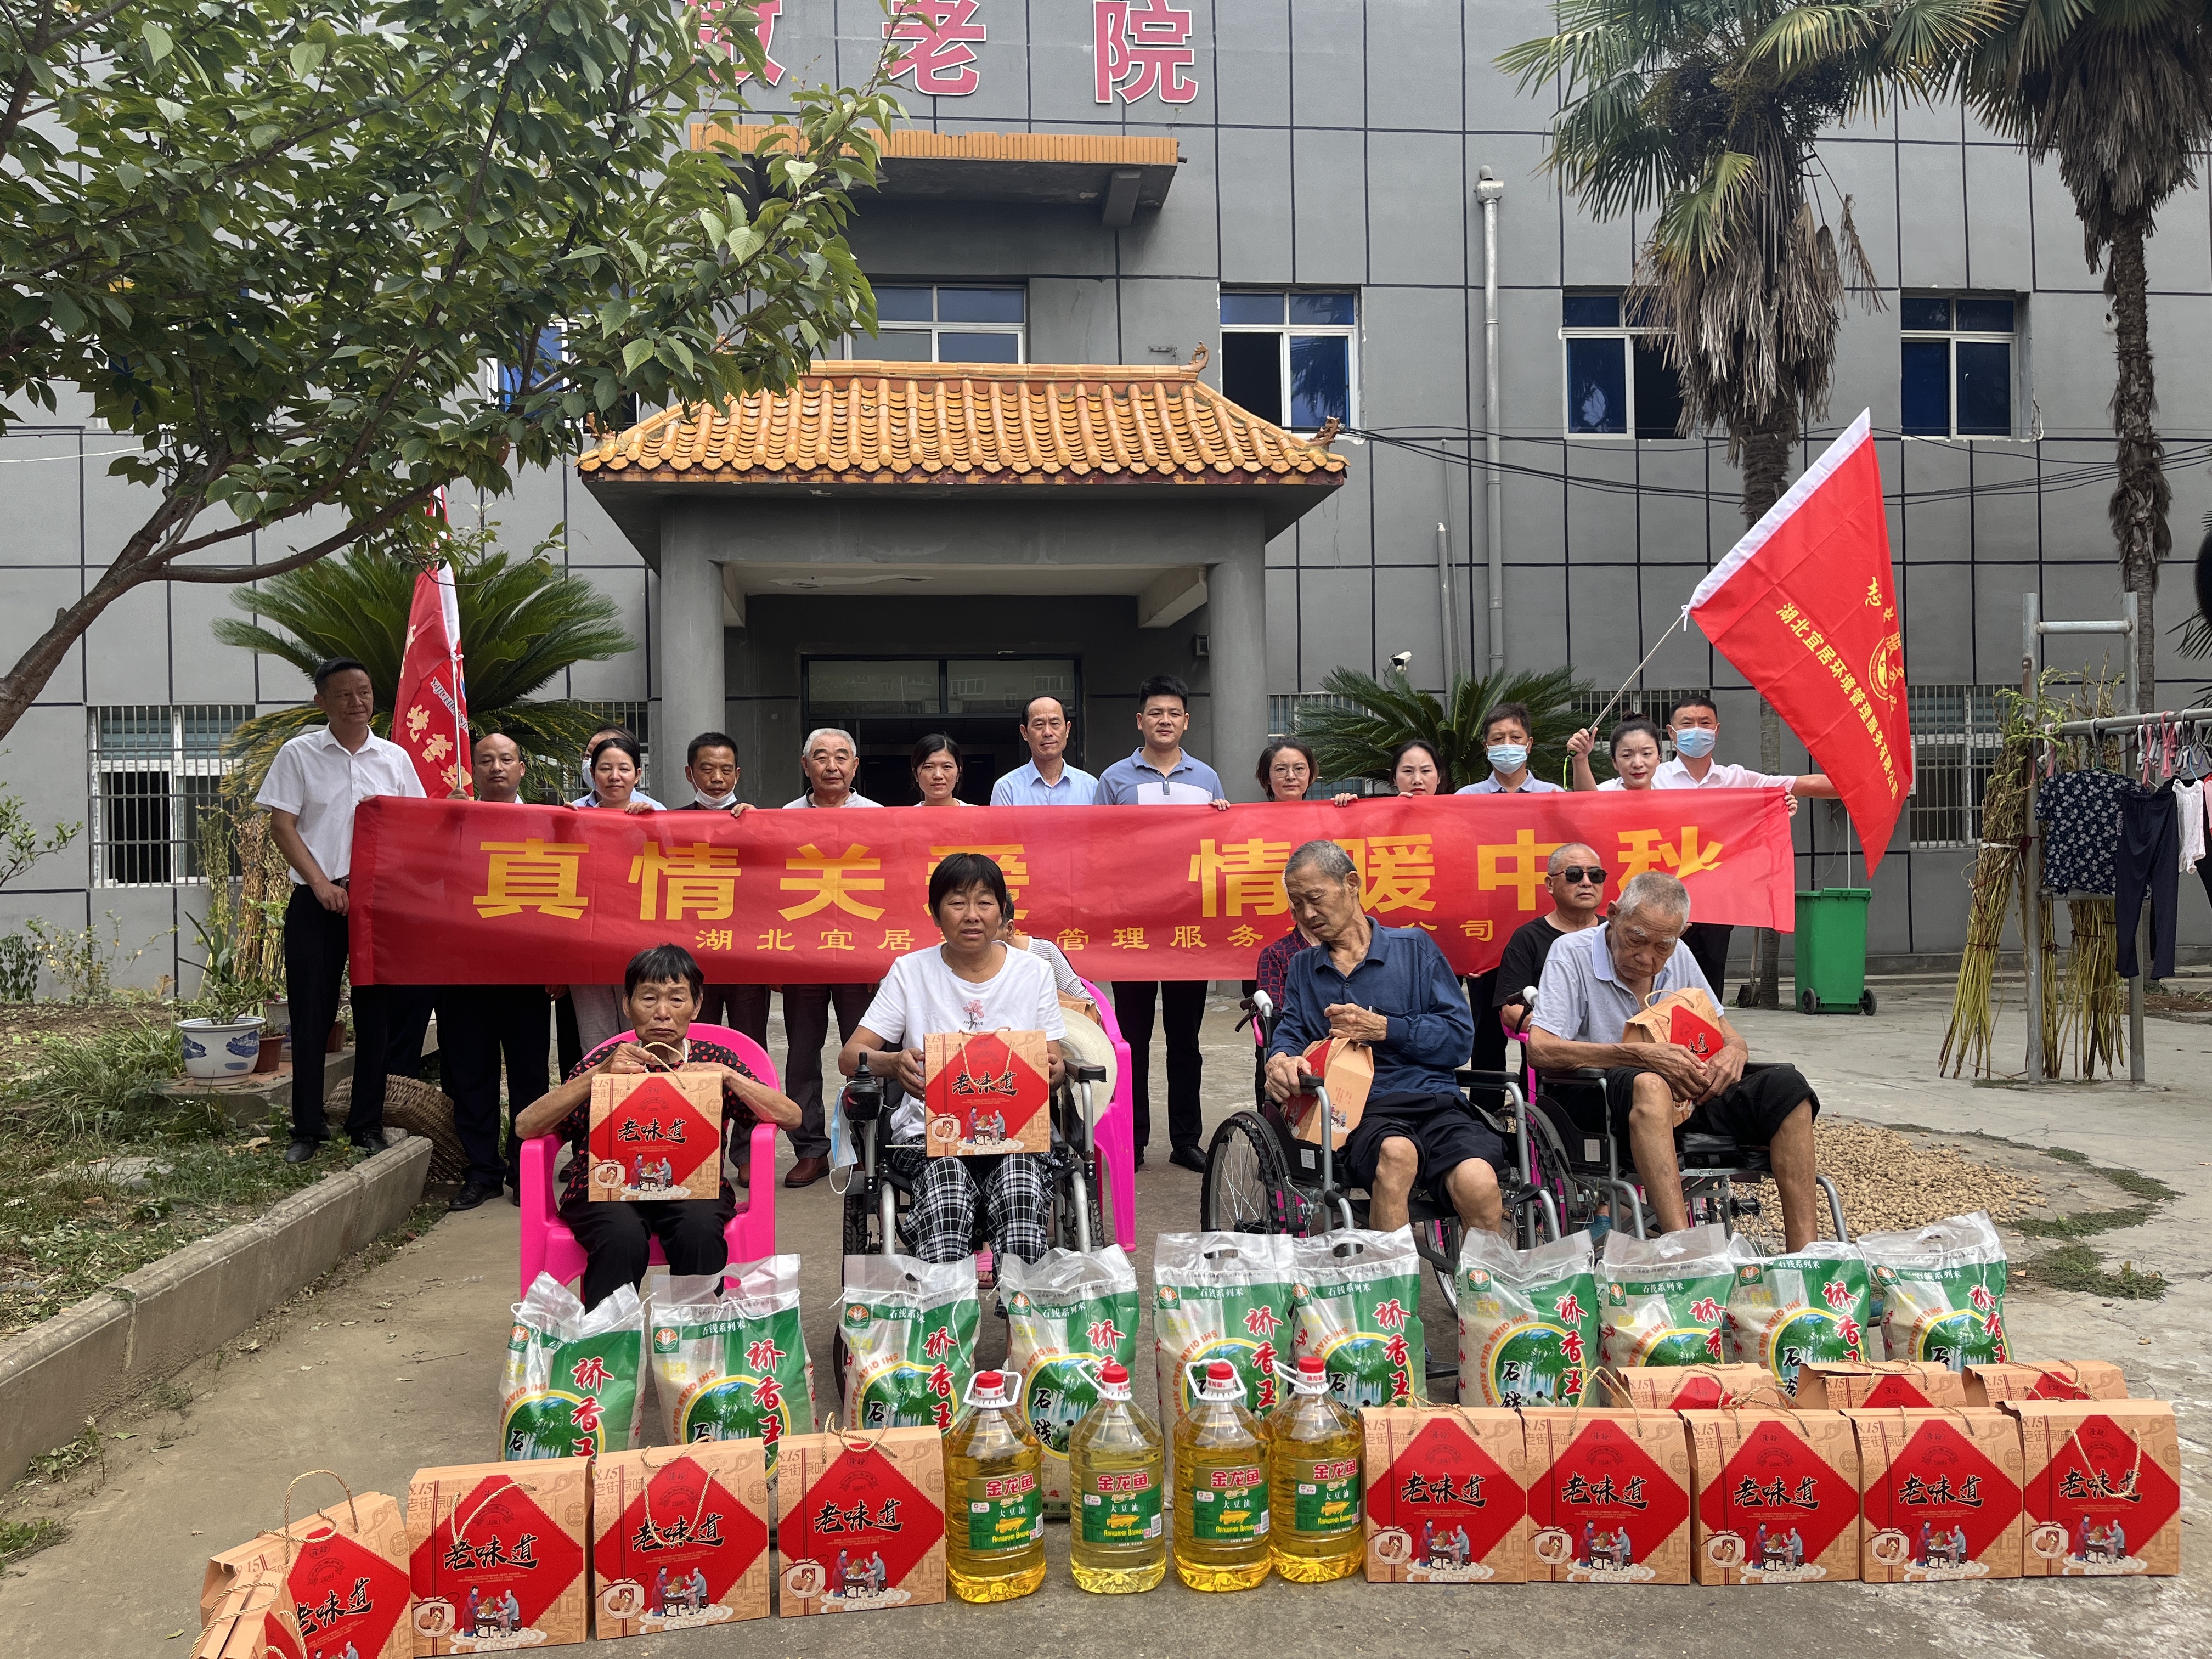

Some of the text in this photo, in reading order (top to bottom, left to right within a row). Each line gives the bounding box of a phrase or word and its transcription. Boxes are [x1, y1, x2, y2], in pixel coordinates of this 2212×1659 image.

[1776, 602, 1899, 800] 湖北宜居环境管理服务有限公司
[951, 1070, 1018, 1096] 老味道
[617, 1116, 687, 1144] 老味道
[1688, 1296, 1728, 1359] 桥香
[1765, 1308, 1785, 1331] QIAN
[881, 1352, 899, 1365] SHI
[1243, 1305, 1283, 1409] 桥香王
[1312, 1326, 1350, 1356] SHI QIAN
[1372, 1298, 1411, 1398] 桥香王
[1480, 1313, 1530, 1406] SHI QIAN QIAO XIANG
[1553, 1294, 1589, 1396] 桥香王
[1758, 1331, 1770, 1357] QIAO
[1907, 1330, 1918, 1356] QIAO
[922, 1326, 957, 1430] 桥香王
[1172, 1330, 1218, 1417] SHI QIAN QIAO XIAN
[673, 1369, 717, 1435] SHI QIAN QIAO
[744, 1338, 787, 1447] 桥香王
[985, 1472, 1034, 1498] 金龙鱼
[1097, 1472, 1149, 1492] 金龙鱼
[1210, 1468, 1261, 1488] 金龙鱼
[1313, 1458, 1358, 1480] 金龙鱼
[2058, 1466, 2143, 1503] 老味道
[1222, 1499, 1251, 1509] 大豆油
[1324, 1489, 1349, 1501] 大豆油
[1401, 1470, 1487, 1509] 老味道
[1561, 1471, 1649, 1510] 老味道
[1733, 1474, 1820, 1510] 老味道
[1898, 1472, 1985, 1509] 老味道
[813, 1497, 904, 1534] 老味道
[998, 1507, 1026, 1519] 大豆油
[1109, 1503, 1139, 1514] 大豆油
[631, 1511, 726, 1553] 老味道
[442, 1532, 539, 1572] 老味道
